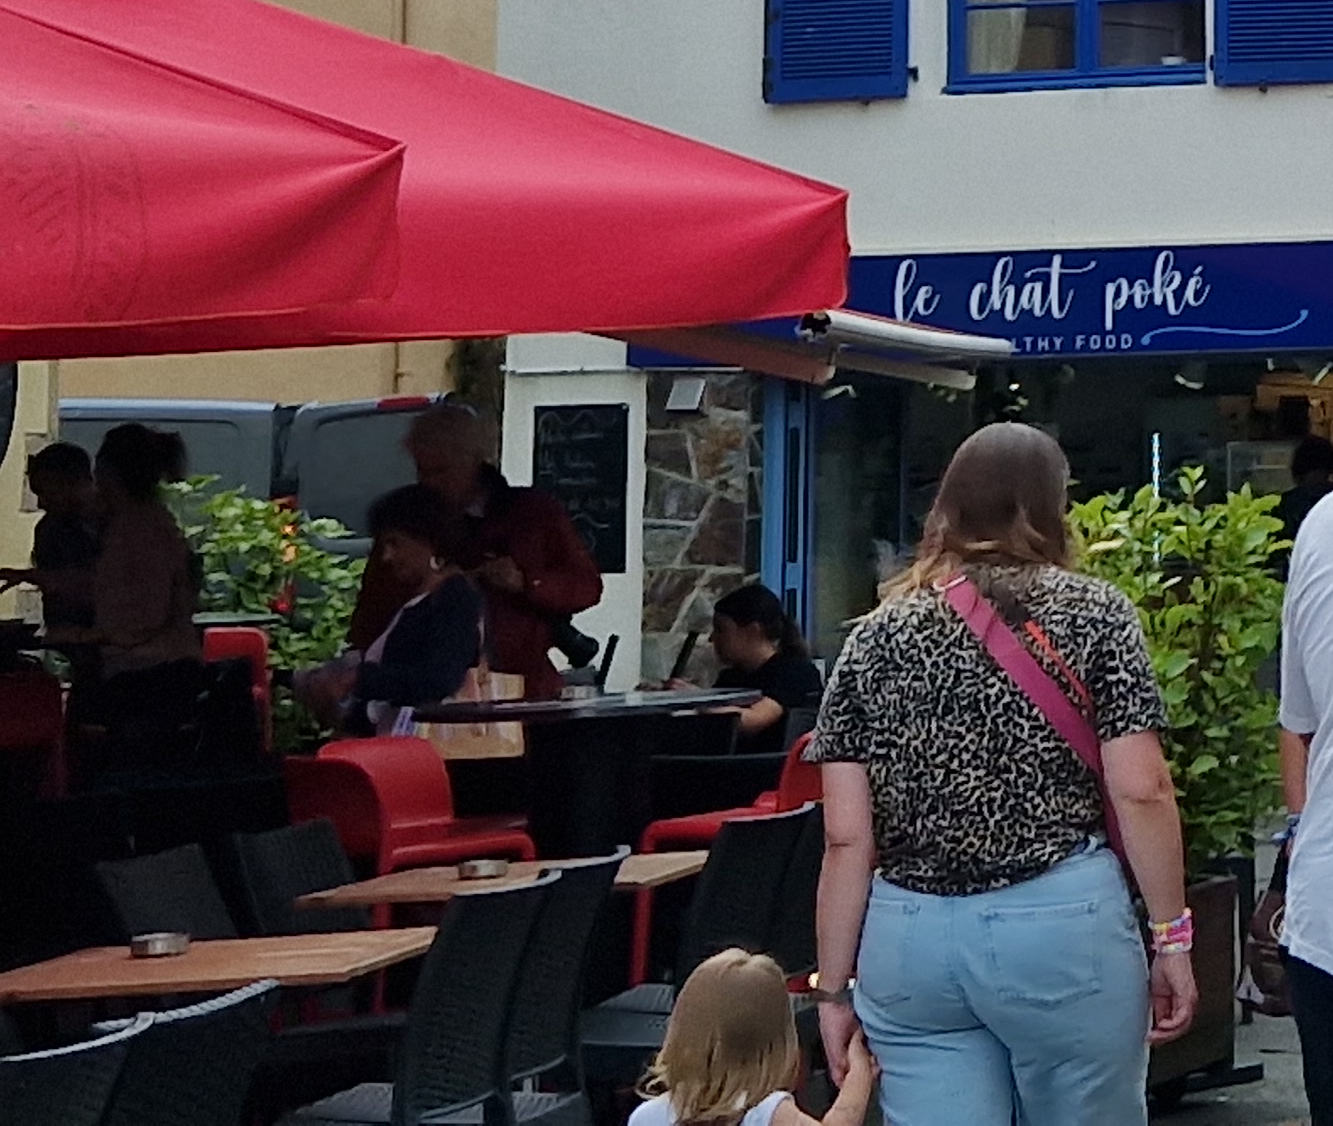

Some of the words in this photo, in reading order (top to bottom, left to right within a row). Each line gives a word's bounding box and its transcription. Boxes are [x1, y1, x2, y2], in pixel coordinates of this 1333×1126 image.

[893, 258, 940, 322] le
[969, 253, 1097, 322] chat
[1103, 250, 1211, 331] poké
[1075, 333, 1133, 350] FOOD
